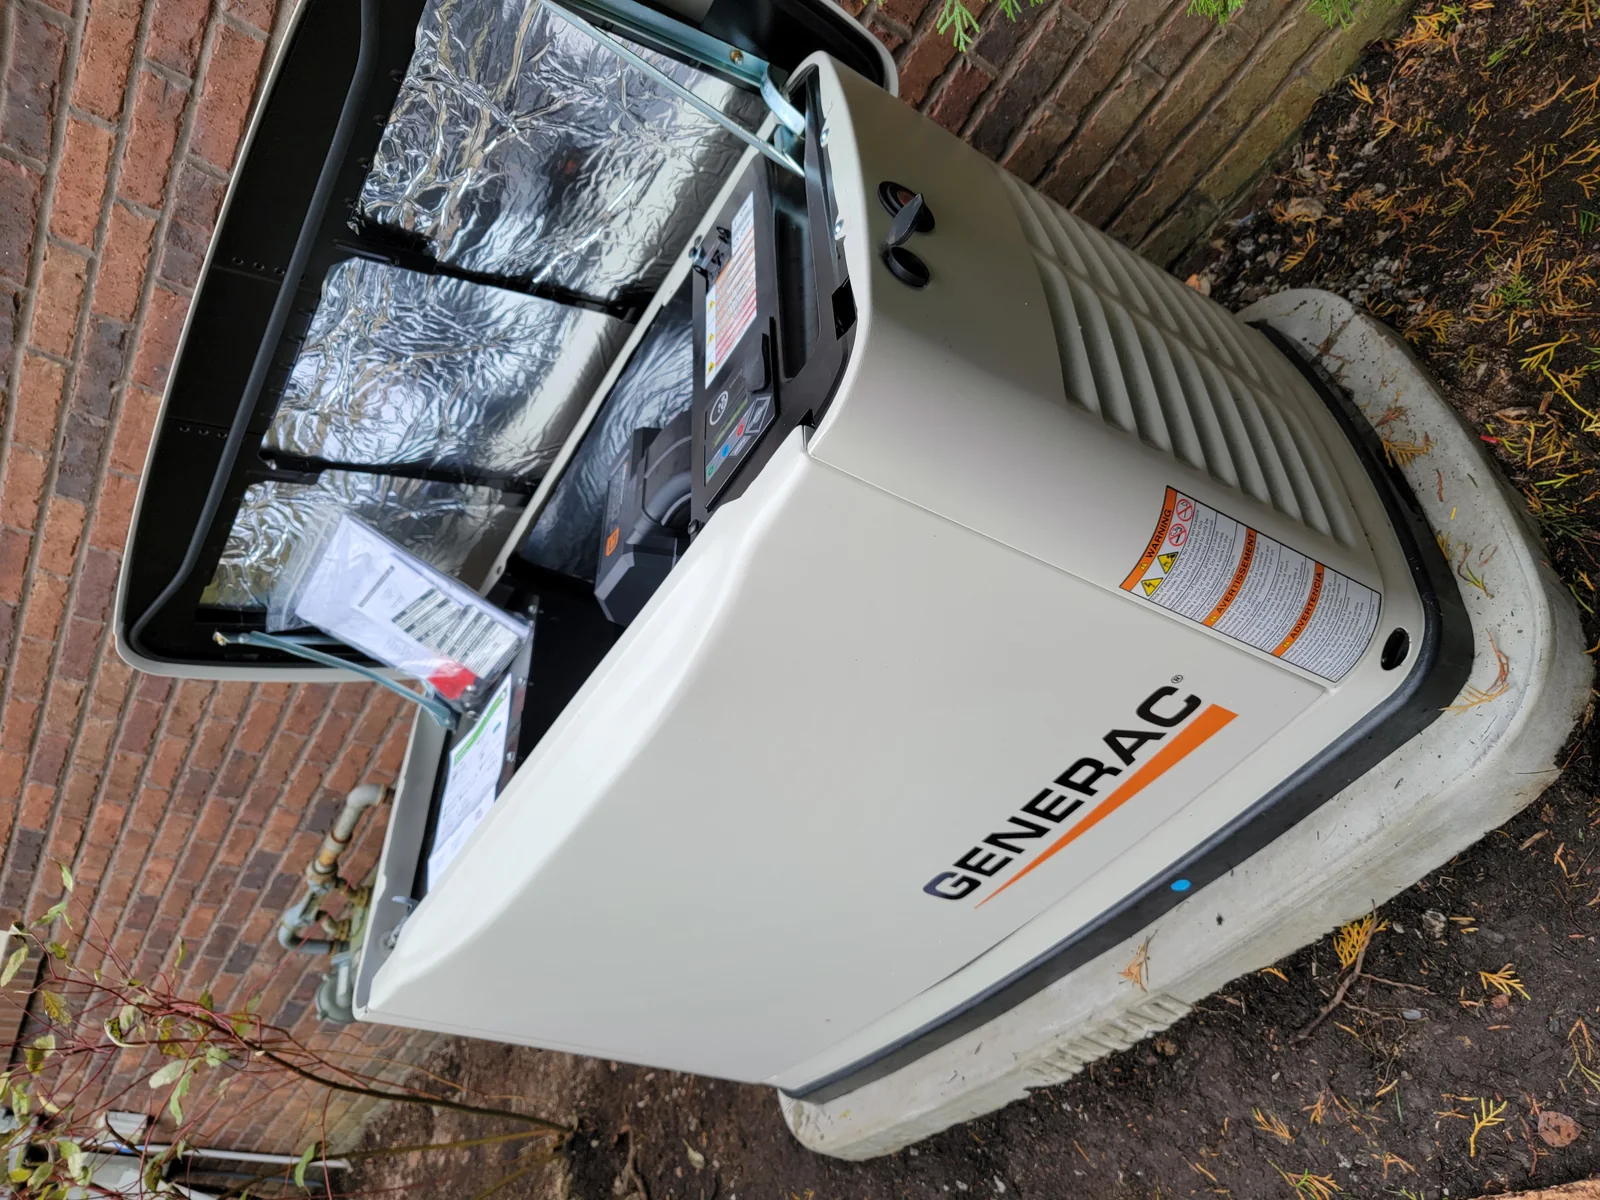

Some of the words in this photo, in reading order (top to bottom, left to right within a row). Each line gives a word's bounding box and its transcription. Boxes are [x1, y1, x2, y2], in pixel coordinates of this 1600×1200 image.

[1145, 509, 1172, 560] WARNING
[1216, 533, 1255, 614] AVERTISSEMENT
[1289, 571, 1322, 639] ADVERTENCIA
[922, 685, 1202, 901] GENERAC
